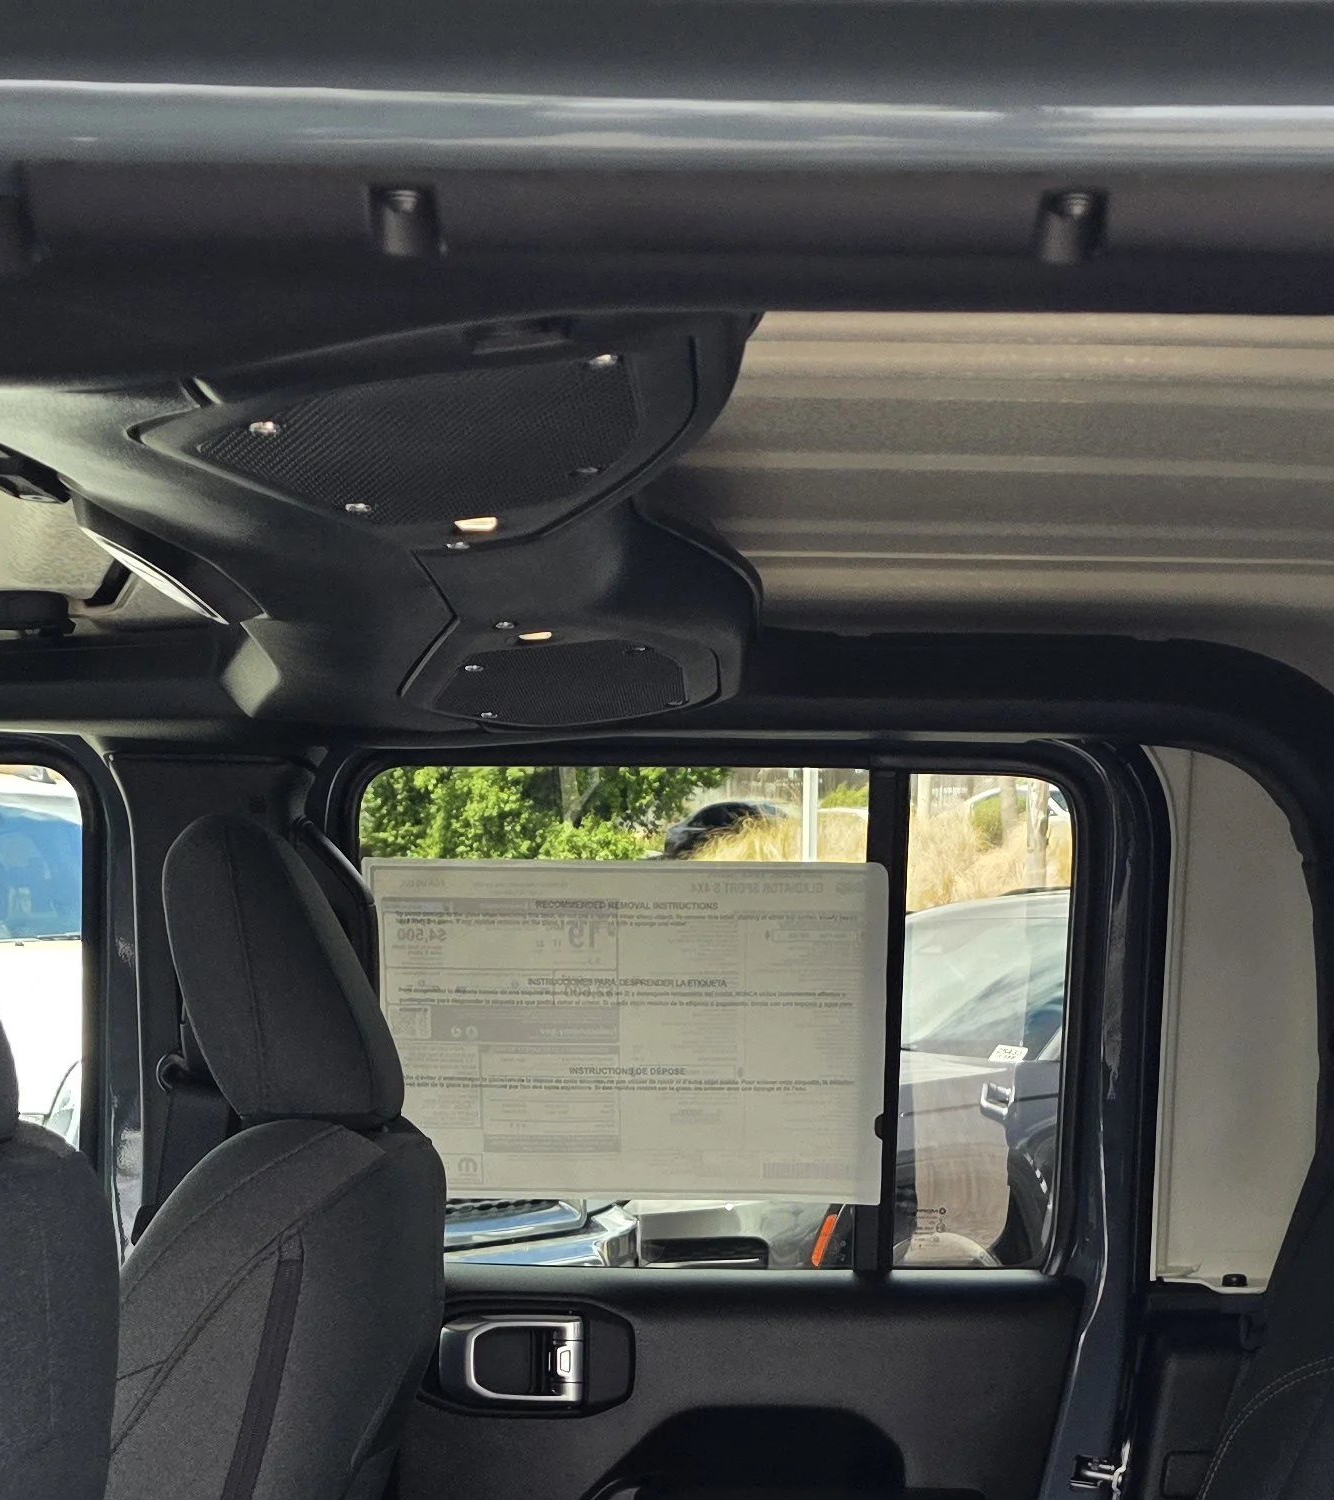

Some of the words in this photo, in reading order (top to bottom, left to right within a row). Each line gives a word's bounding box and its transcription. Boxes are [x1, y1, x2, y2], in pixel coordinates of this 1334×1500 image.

[535, 901, 606, 910] RECOMMENDED
[608, 901, 651, 910] REMOVAL
[653, 902, 719, 911] INSTRUCTIONS
[594, 978, 616, 986] PARA
[619, 978, 674, 987] DESPRENDER
[675, 979, 687, 987] LA
[687, 979, 728, 988] ETIQUETA
[569, 1066, 634, 1076] INSTRUCTIONS
[635, 1067, 648, 1076] DE
[649, 1066, 687, 1076] DÉPOSE
